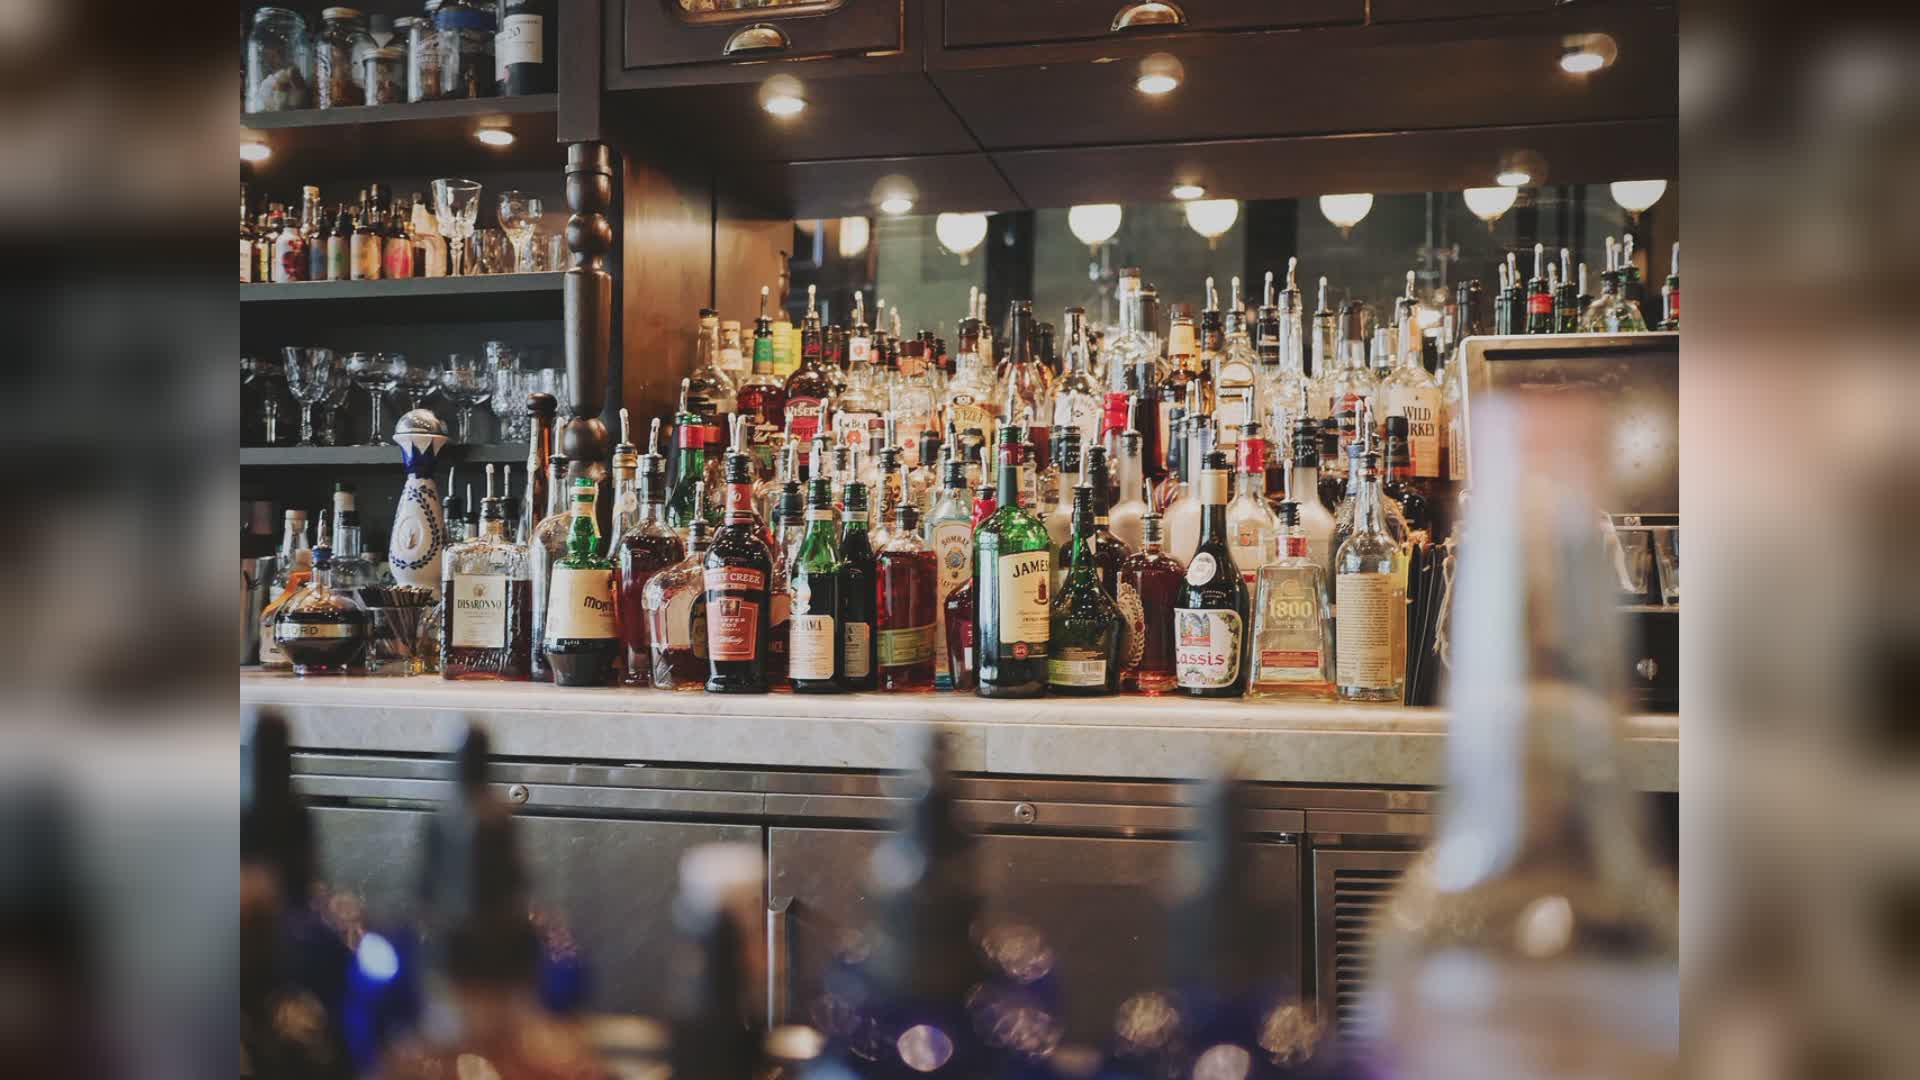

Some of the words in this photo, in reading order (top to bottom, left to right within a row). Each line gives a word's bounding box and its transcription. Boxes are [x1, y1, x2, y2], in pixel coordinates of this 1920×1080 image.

[1403, 406, 1431, 421] WILD
[729, 572, 760, 584] CREEK
[457, 599, 502, 610] DISARONNO
[1269, 598, 1312, 618] 1800
